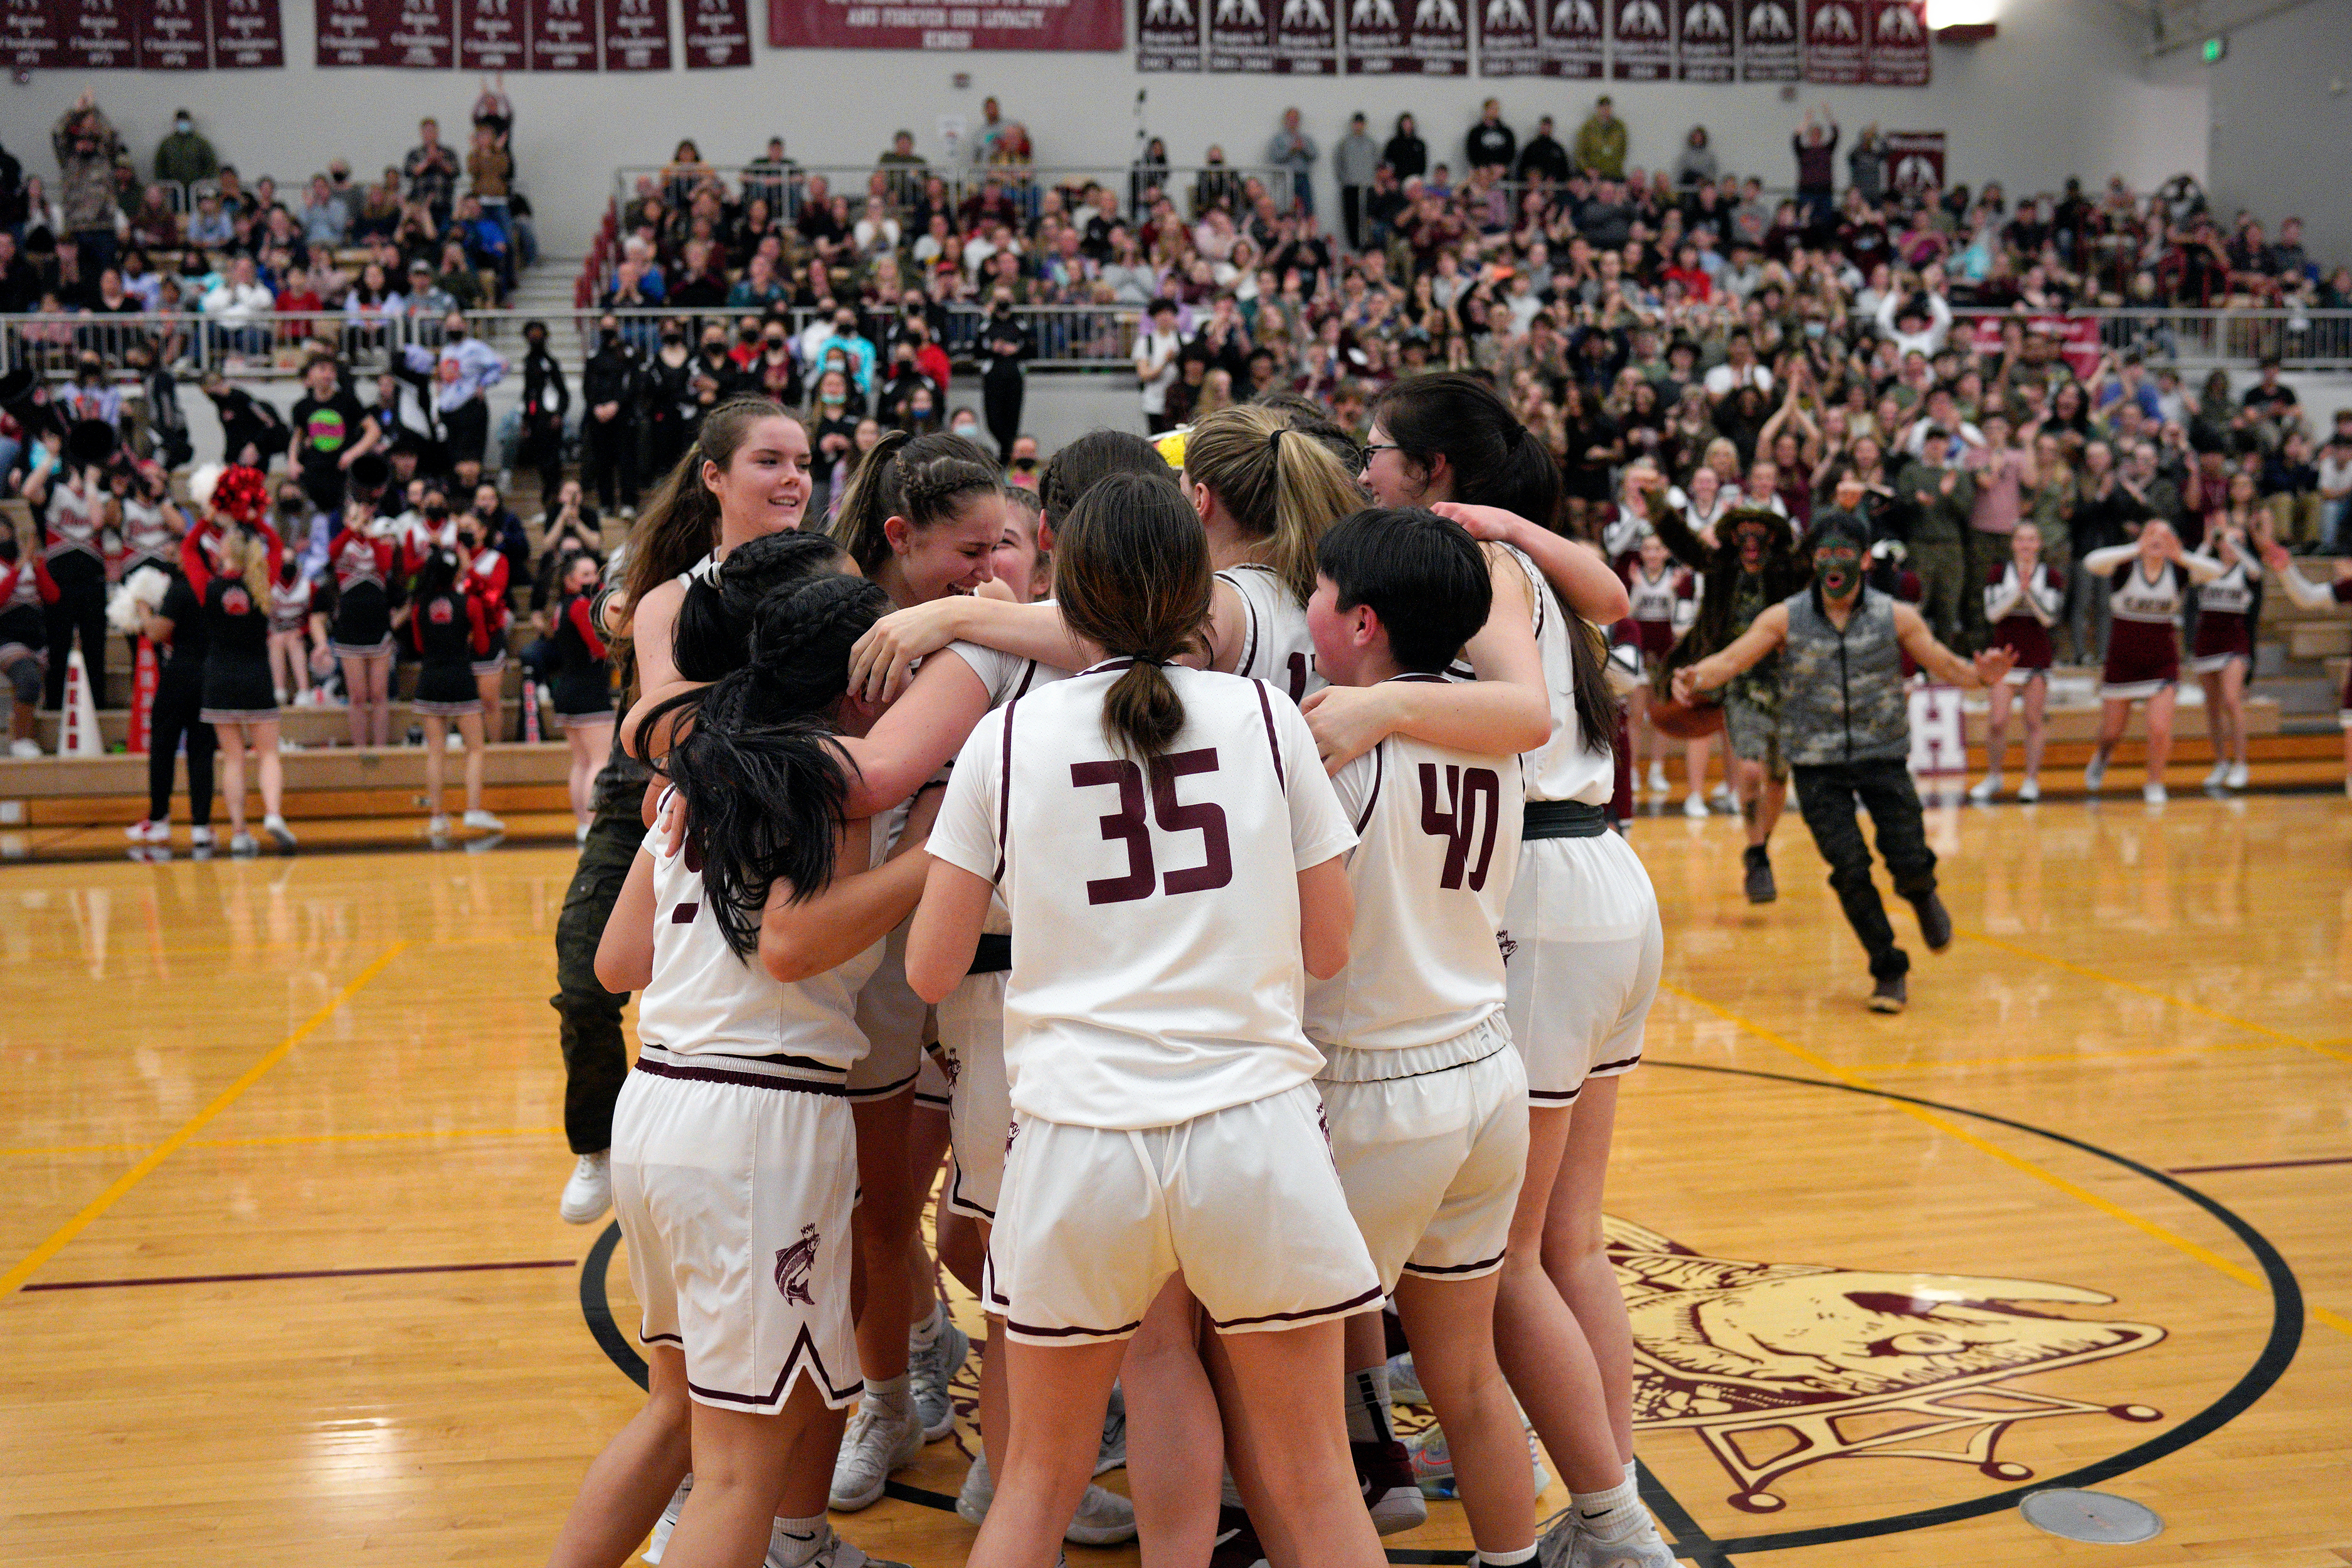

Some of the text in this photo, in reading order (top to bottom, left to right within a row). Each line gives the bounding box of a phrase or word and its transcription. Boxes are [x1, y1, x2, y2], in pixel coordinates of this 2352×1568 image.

[1287, 652, 1316, 706] 1
[1070, 748, 1233, 905] 35
[1419, 763, 1499, 892] 40
